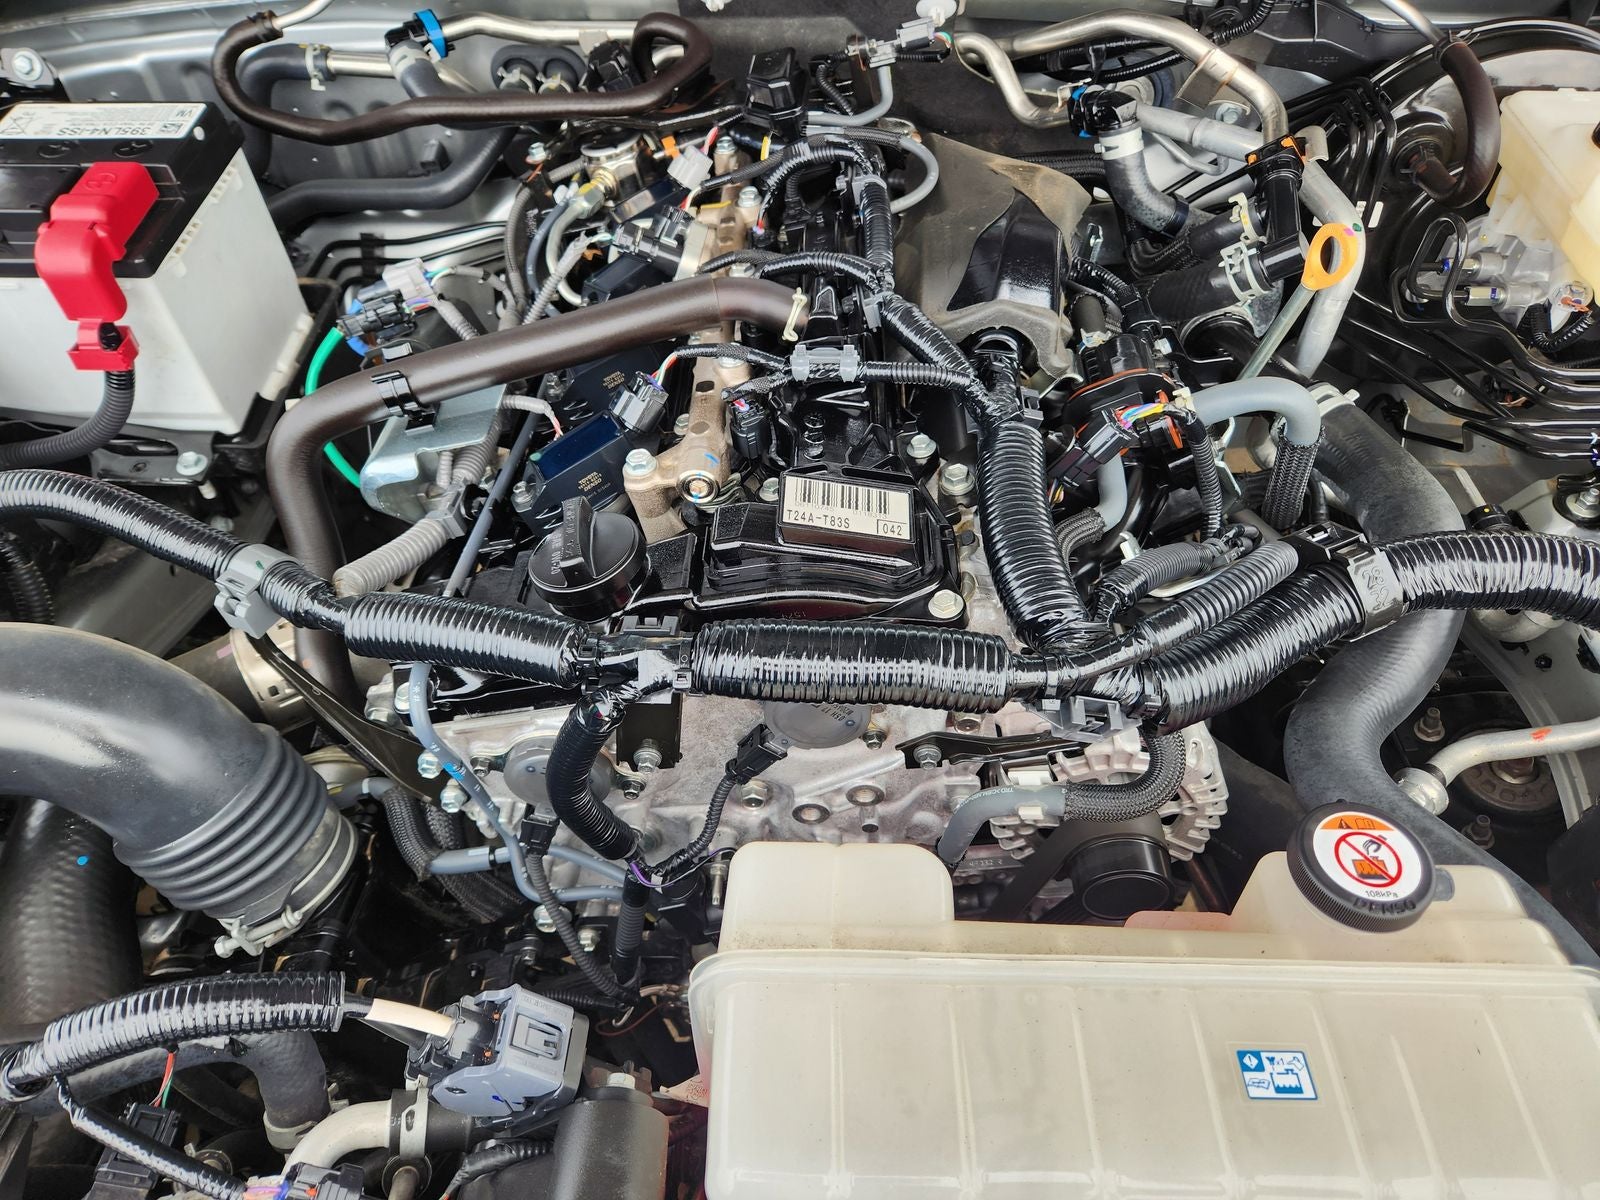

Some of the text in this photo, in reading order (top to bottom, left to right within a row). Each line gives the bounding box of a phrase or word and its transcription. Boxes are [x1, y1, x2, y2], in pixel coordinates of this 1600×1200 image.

[787, 510, 902, 536] T24A-T83S 042
[1365, 890, 1399, 898] 108kPa
[1353, 897, 1416, 915] DENSO
